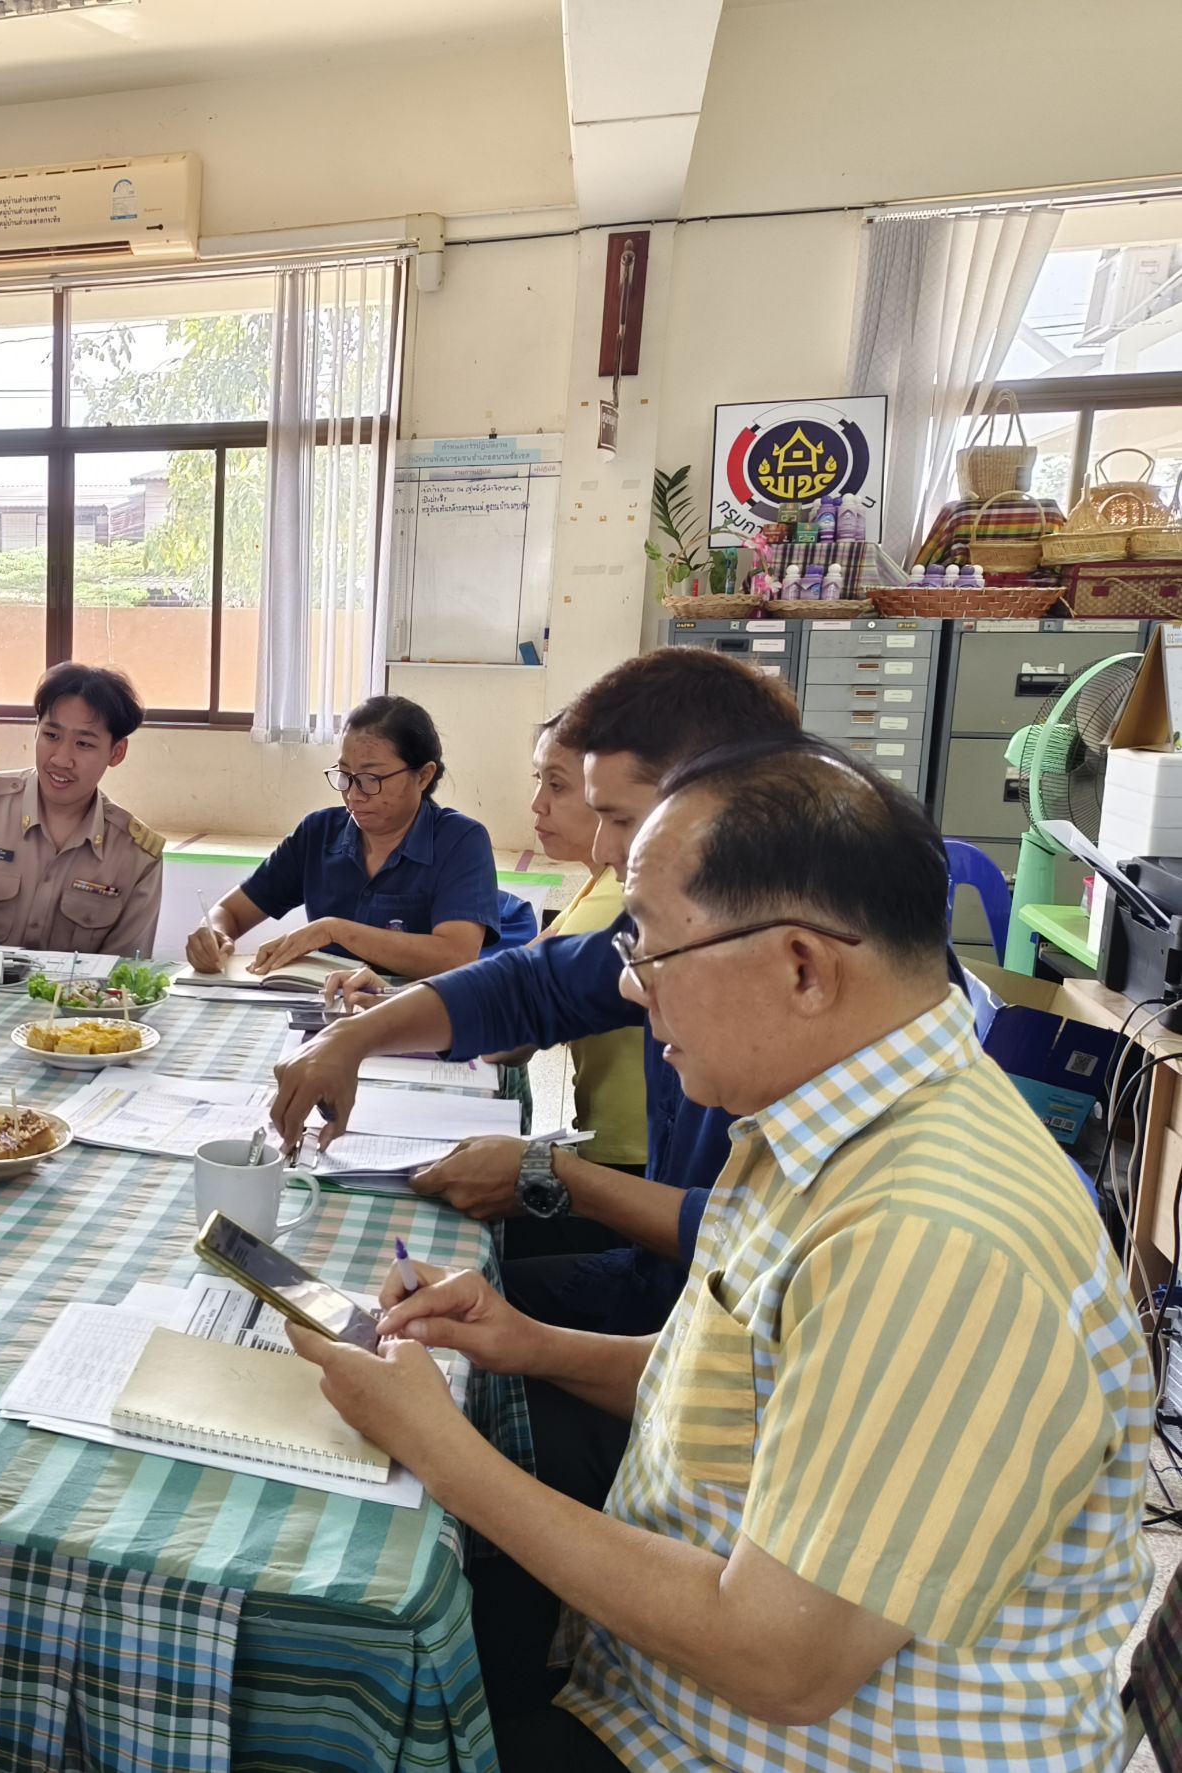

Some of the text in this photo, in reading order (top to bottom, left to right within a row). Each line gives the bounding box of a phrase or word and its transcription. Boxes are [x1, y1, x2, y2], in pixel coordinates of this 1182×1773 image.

[408, 451, 531, 463] นักงานพัฒนาชุมชนอำเภอสนามชัยเขต
